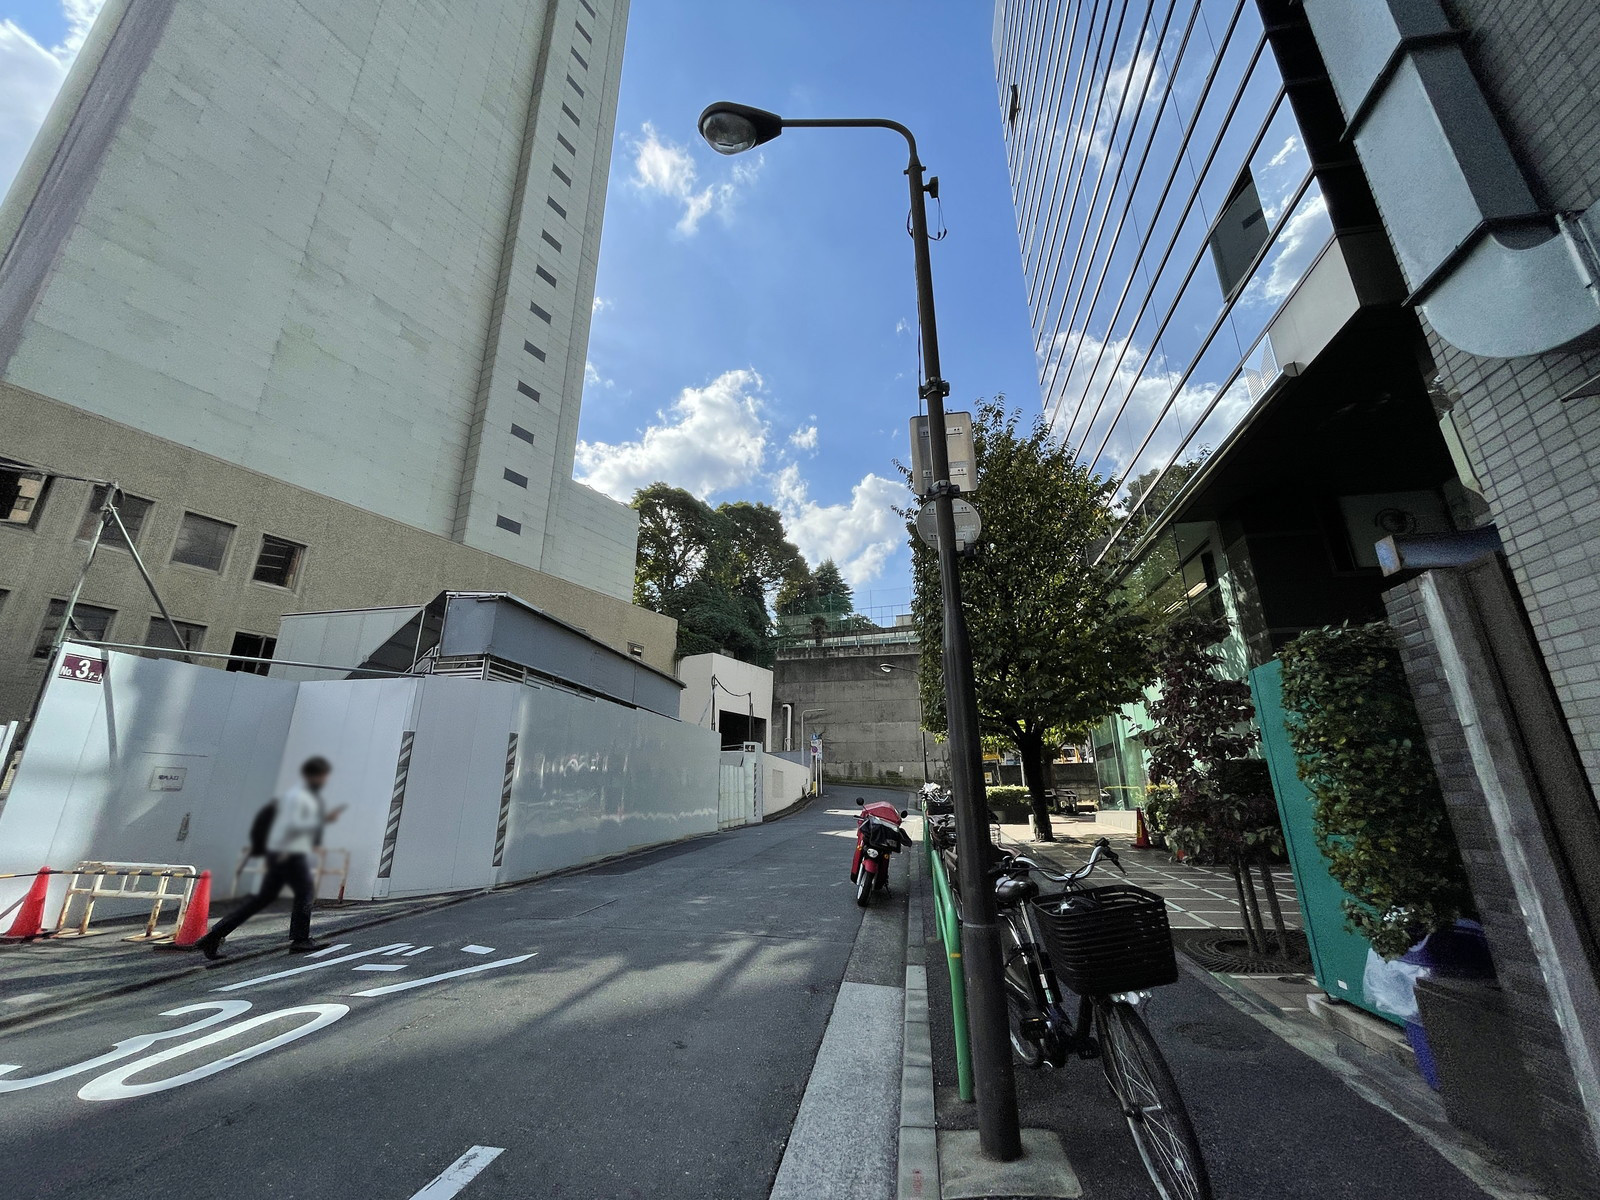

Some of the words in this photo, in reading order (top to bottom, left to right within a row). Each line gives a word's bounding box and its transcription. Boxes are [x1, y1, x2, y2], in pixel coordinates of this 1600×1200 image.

[59, 665, 73, 677] No.
[75, 659, 91, 679] 3
[0, 1000, 351, 1100] 30
